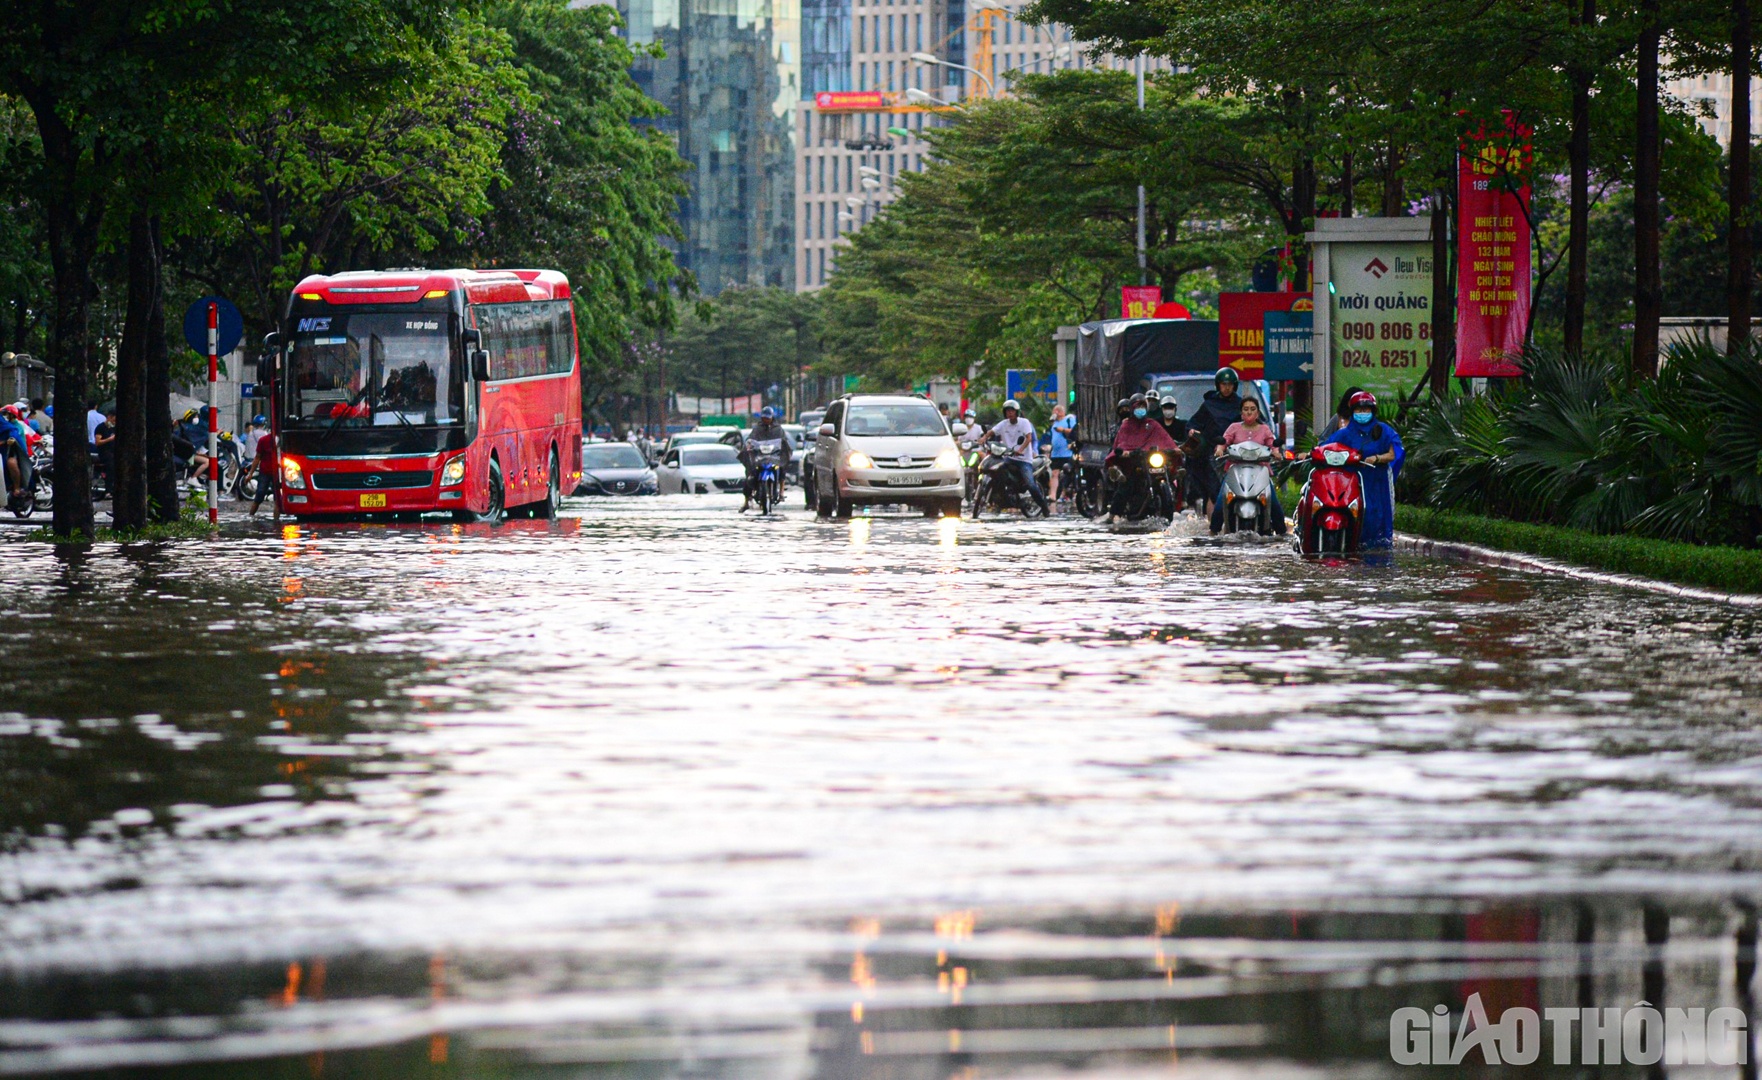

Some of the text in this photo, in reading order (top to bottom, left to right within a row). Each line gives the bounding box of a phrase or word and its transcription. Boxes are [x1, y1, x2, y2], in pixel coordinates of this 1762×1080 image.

[1471, 230, 1493, 242] CHÀO
[1478, 245, 1511, 257] 132 NĂM
[1394, 256, 1414, 273] New
[1473, 259, 1515, 272] NGÀY SINH
[1477, 273, 1511, 288] CHỦ TỊCH
[1339, 291, 1428, 311] MỜI QUẢNG
[1469, 287, 1518, 301] HỒ CHÍ MINH
[1128, 301, 1156, 318] 19-5
[405, 321, 413, 329] XE
[413, 321, 424, 330] HỢP
[1342, 322, 1375, 340] 090
[1380, 322, 1413, 340] 806
[1228, 329, 1264, 347] THAN
[1342, 349, 1376, 368] 024.
[1380, 349, 1417, 368] 6251
